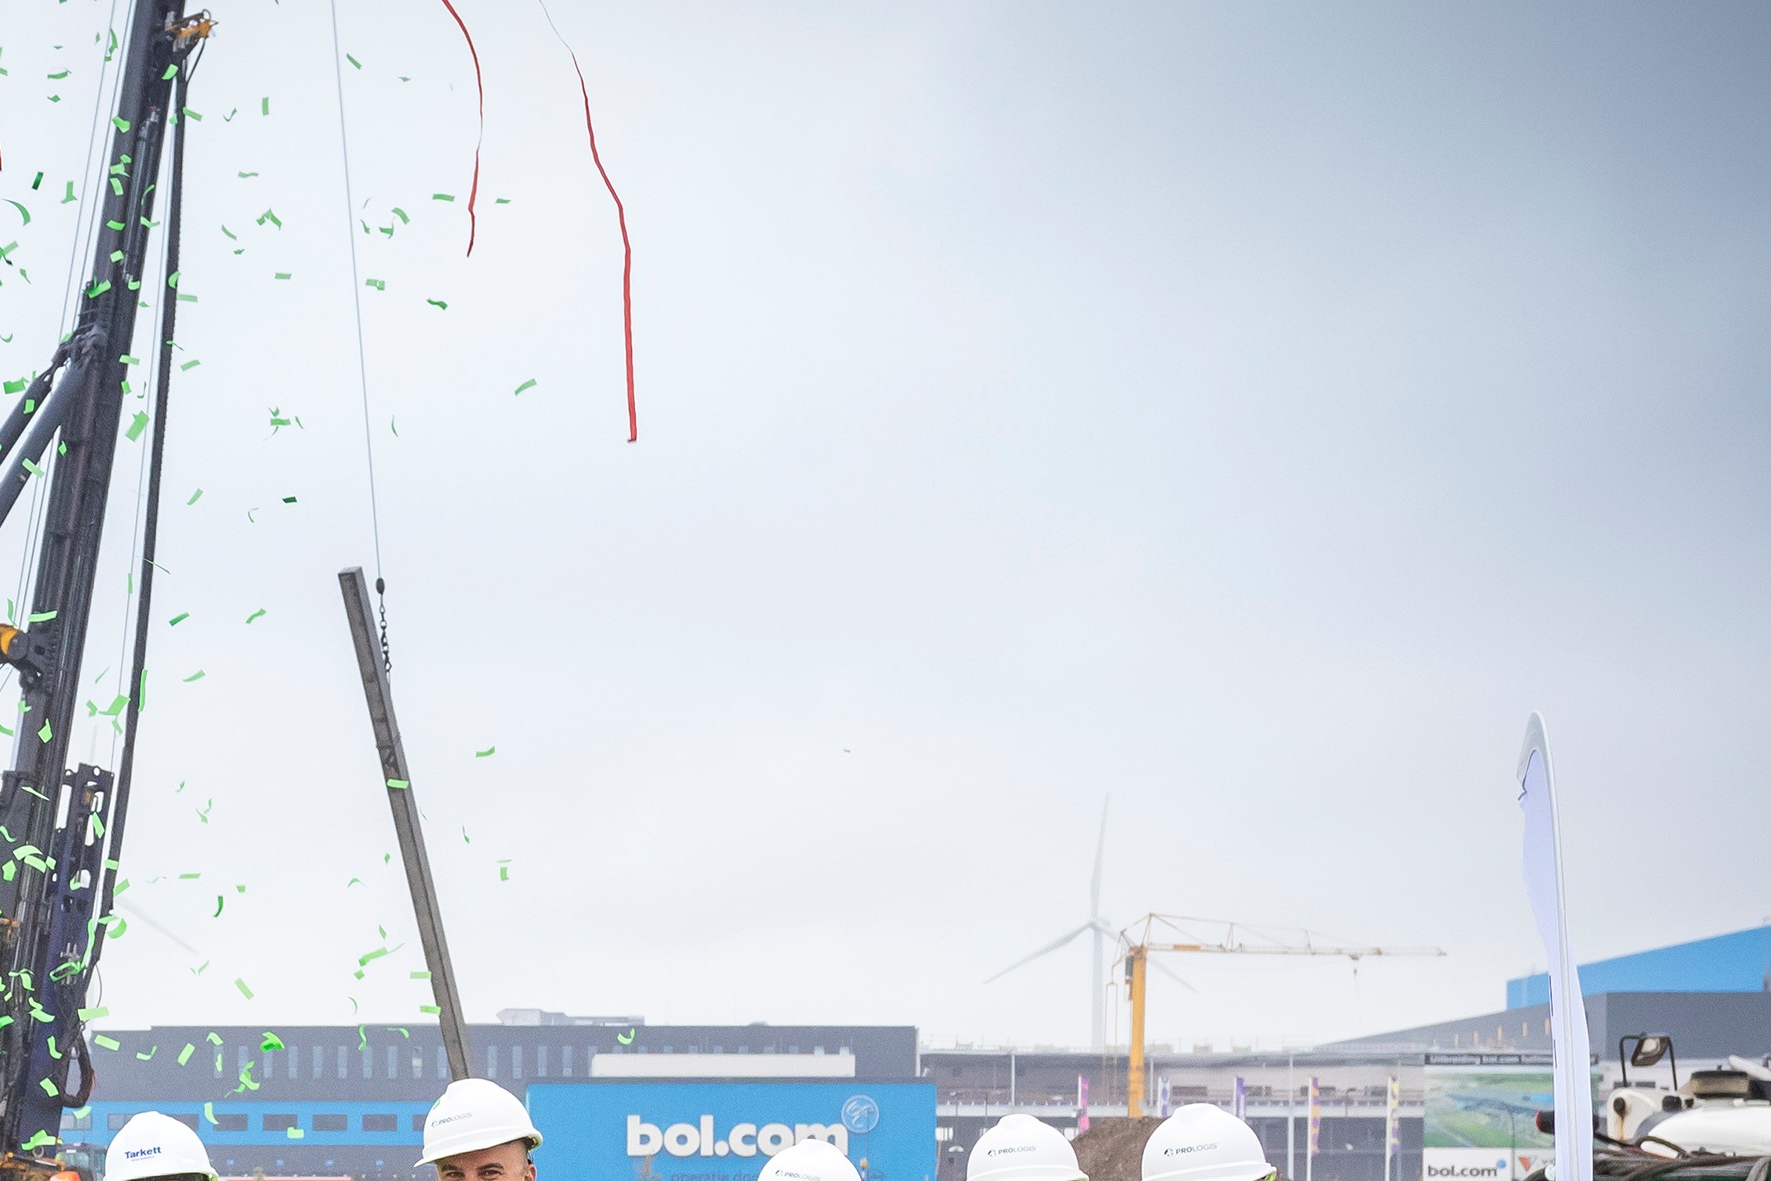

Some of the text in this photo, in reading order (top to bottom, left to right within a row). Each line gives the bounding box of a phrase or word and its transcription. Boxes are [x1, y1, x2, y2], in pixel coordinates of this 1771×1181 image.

[627, 1114, 849, 1157] bol.com
[124, 1146, 162, 1159] Tarkett
[997, 1145, 1037, 1155] PROLOGIS
[1176, 1142, 1219, 1155] PROLOGIS
[1427, 1164, 1498, 1178] bol.com
